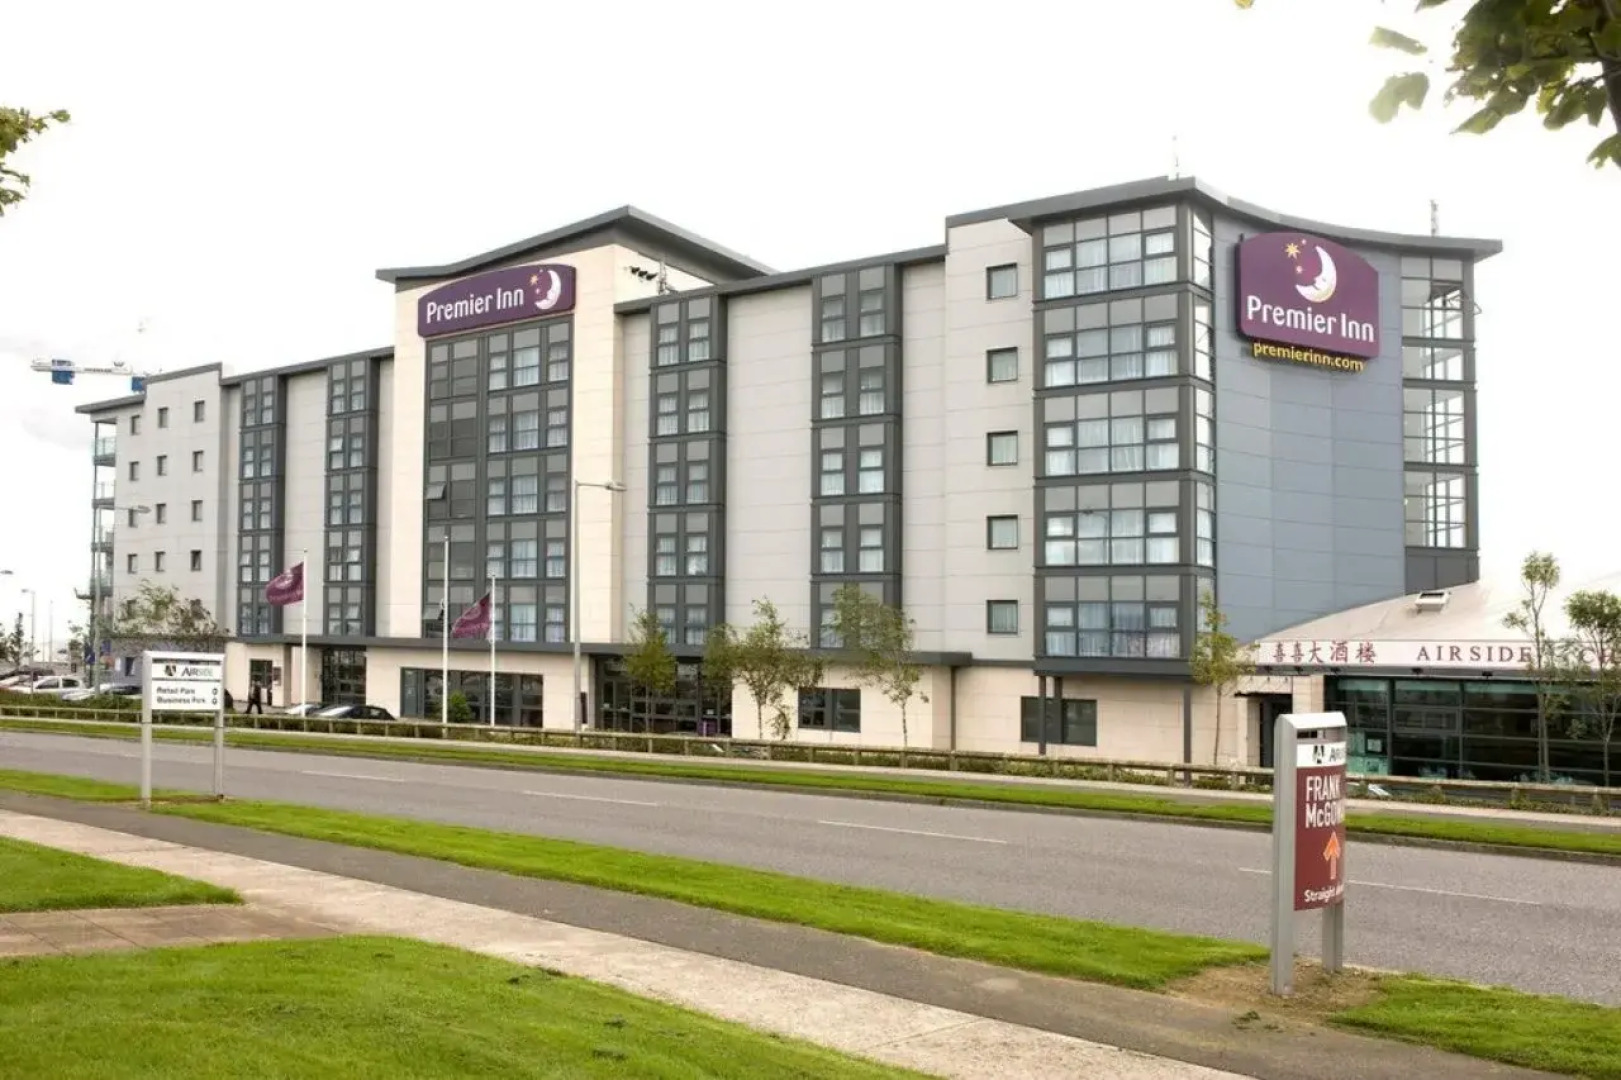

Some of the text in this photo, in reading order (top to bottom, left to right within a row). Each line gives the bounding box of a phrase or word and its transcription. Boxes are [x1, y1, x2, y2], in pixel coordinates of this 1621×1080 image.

[426, 288, 524, 324] Premier Inn
[1246, 295, 1375, 342] Premier Inn
[1253, 342, 1364, 372] premierinn.com
[1416, 645, 1532, 663] AIRSIDE
[180, 687, 196, 695] Park
